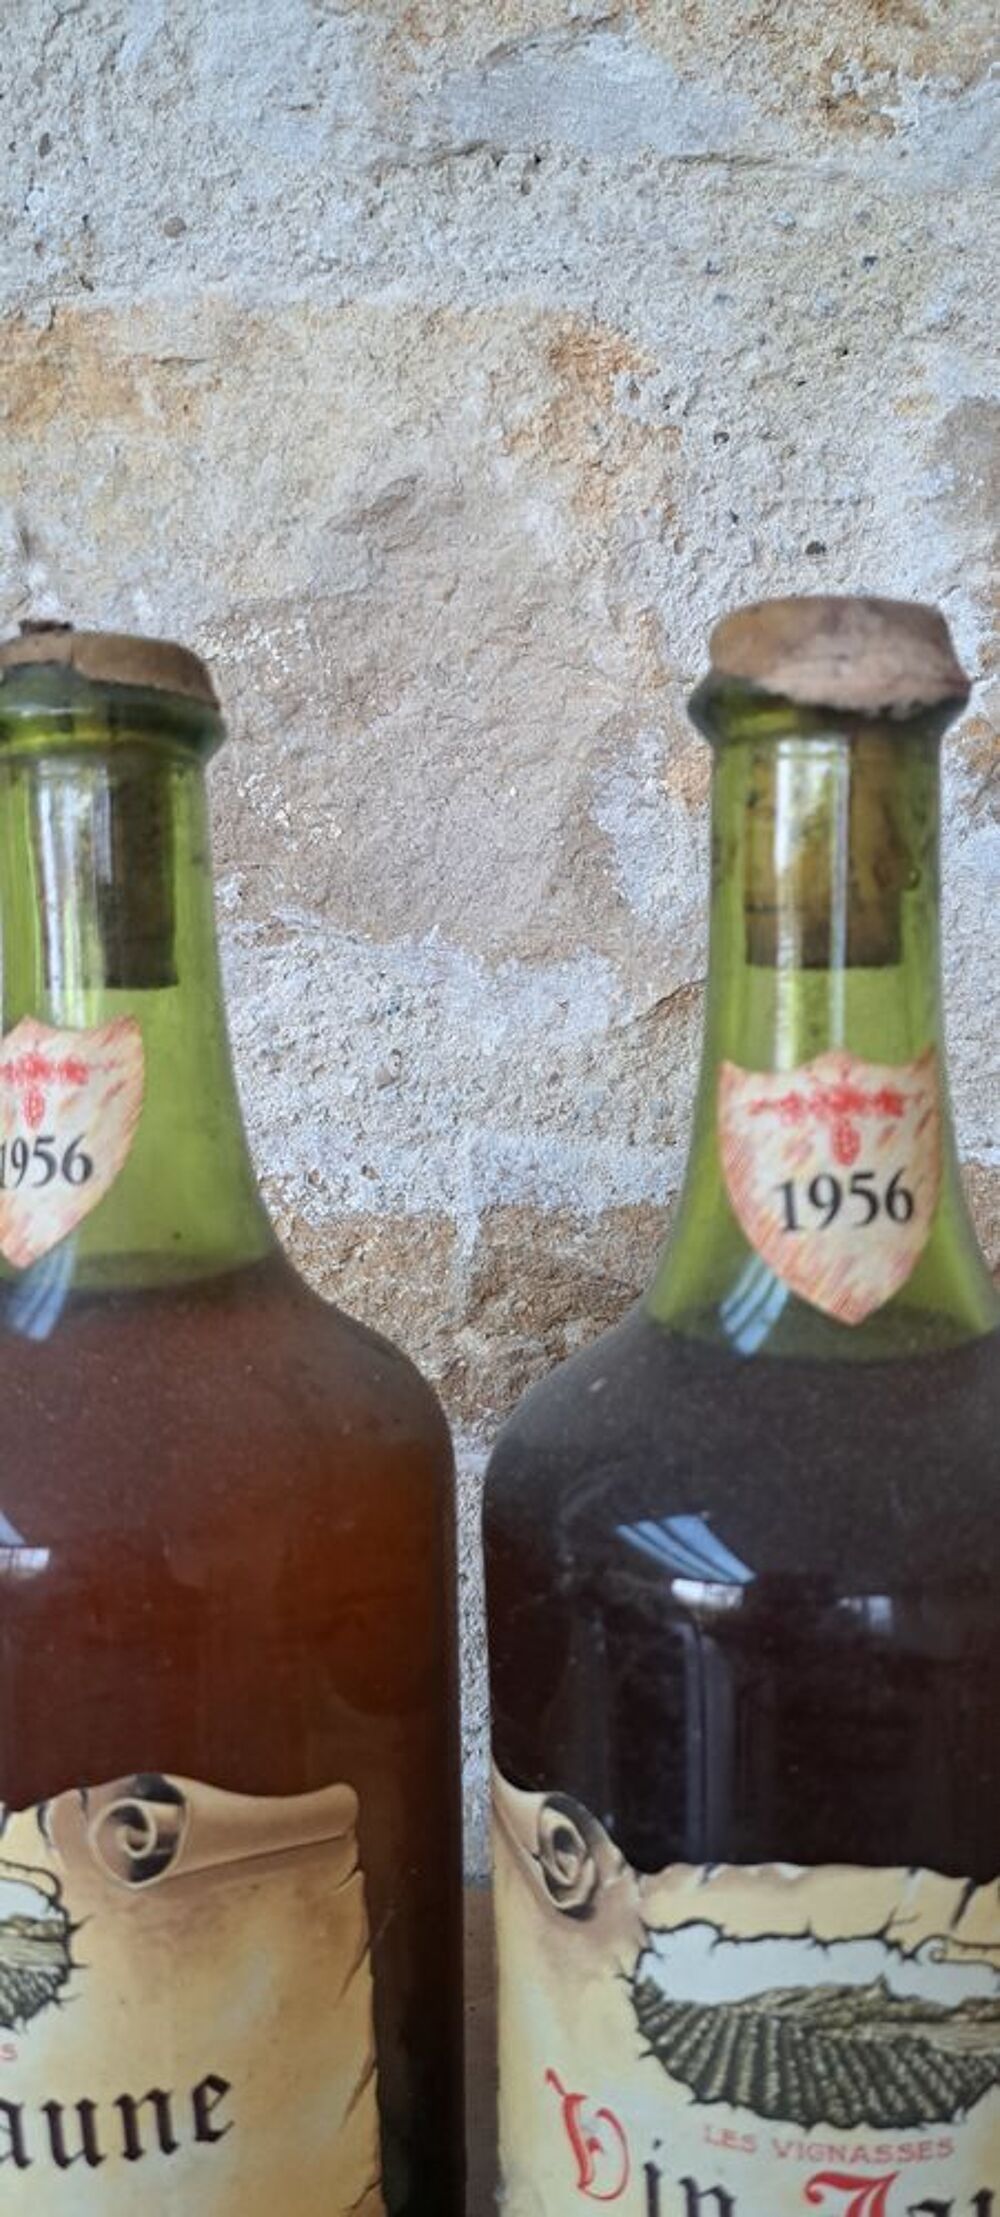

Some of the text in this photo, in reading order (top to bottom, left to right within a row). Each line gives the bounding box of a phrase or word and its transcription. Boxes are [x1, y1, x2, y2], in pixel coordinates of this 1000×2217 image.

[771, 1168, 914, 1233] 1956
[704, 2125, 955, 2165] LES VIGNASSES
